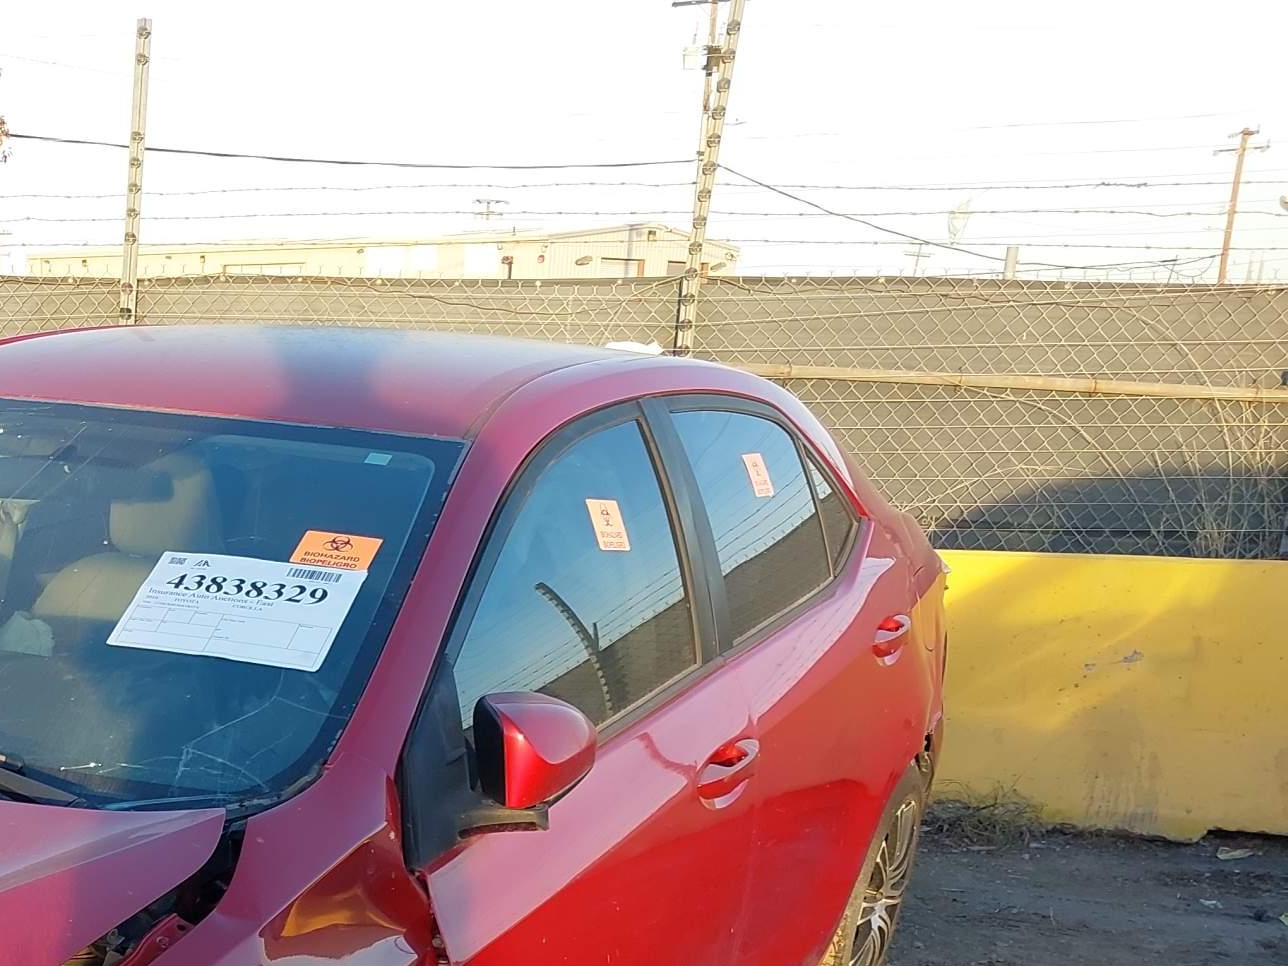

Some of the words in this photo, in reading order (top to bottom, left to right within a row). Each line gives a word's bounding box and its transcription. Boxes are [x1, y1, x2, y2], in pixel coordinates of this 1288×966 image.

[300, 557, 358, 569] BIOPELIGRO
[304, 551, 360, 563] BIOHAZARD
[166, 573, 329, 605] 43838329
[149, 588, 187, 598] Insurance
[189, 592, 210, 600] Auto
[211, 595, 248, 604] Auctions
[255, 599, 275, 607] East
